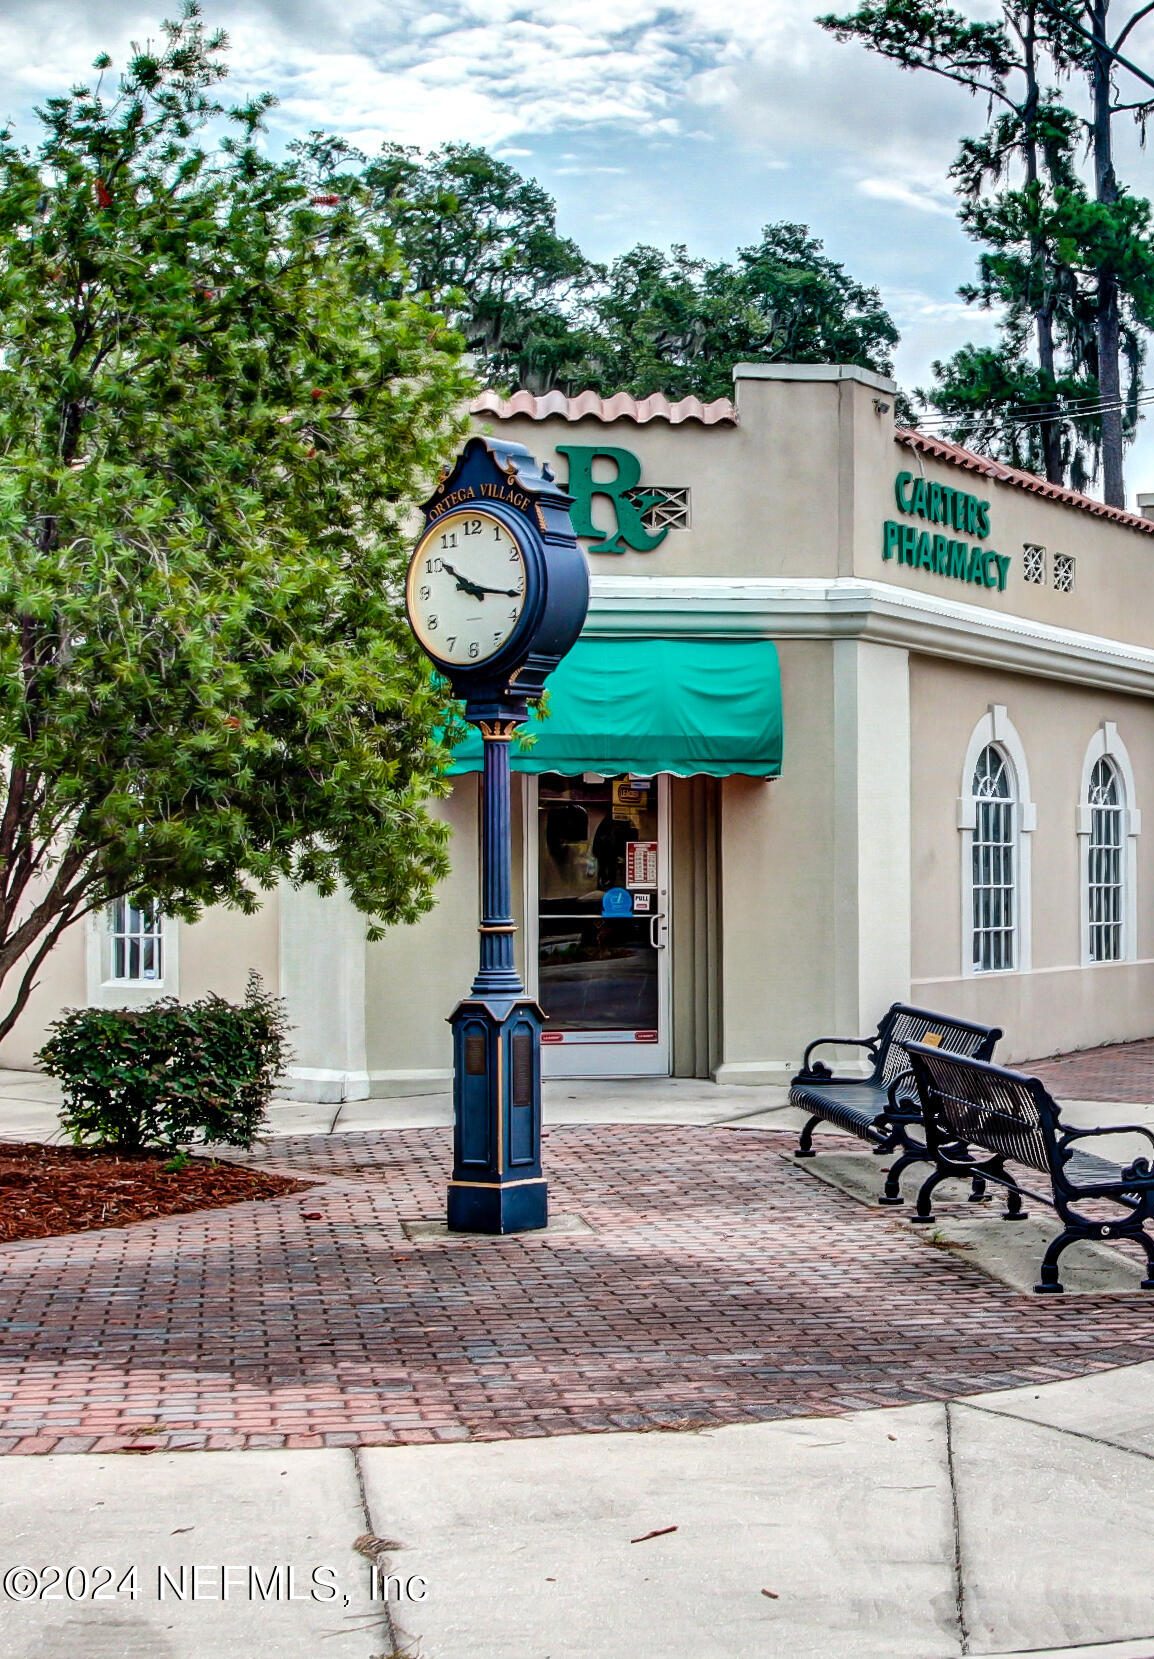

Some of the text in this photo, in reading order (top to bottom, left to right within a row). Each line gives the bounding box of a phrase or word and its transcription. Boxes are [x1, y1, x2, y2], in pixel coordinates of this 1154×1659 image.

[429, 483, 531, 520] ORTEGA VILLAGE
[895, 471, 991, 540] CARTERS
[463, 520, 482, 535] 12
[493, 526, 502, 541] 1
[441, 533, 458, 549] 11
[509, 547, 522, 562] 2
[882, 520, 1011, 592] PHARMACY
[426, 558, 443, 574] 10
[420, 586, 431, 601] 9
[428, 615, 438, 630] 8
[446, 636, 457, 653] 7
[468, 642, 480, 658] 6
